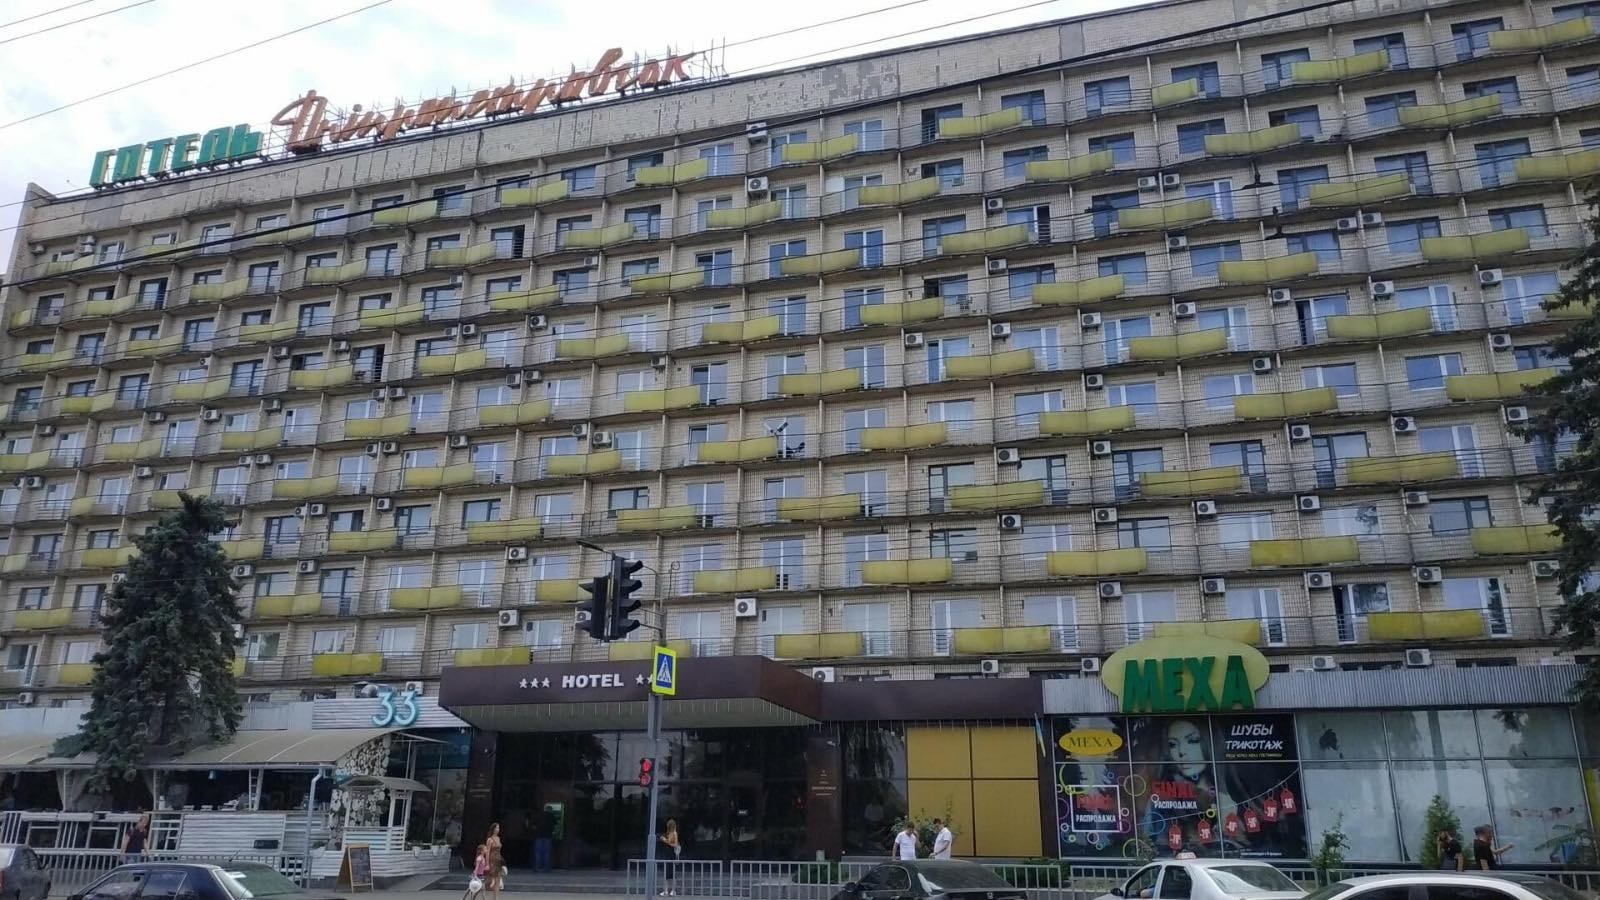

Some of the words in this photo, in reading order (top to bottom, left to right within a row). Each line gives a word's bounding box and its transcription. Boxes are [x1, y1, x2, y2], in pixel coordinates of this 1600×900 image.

[89, 123, 264, 189] ГОТЕЛЬ
[562, 673, 625, 689] HOTEL
[1123, 655, 1255, 714] МЕХА
[372, 691, 417, 727] 33
[1231, 723, 1274, 736] ШУБЫ
[1069, 736, 1114, 748] МЕХА
[1225, 740, 1284, 750] ТРИКОТАЖ
[1154, 801, 1198, 810] РАСПРОДАЖА
[1075, 814, 1117, 823] РАСПРОДАЖА
